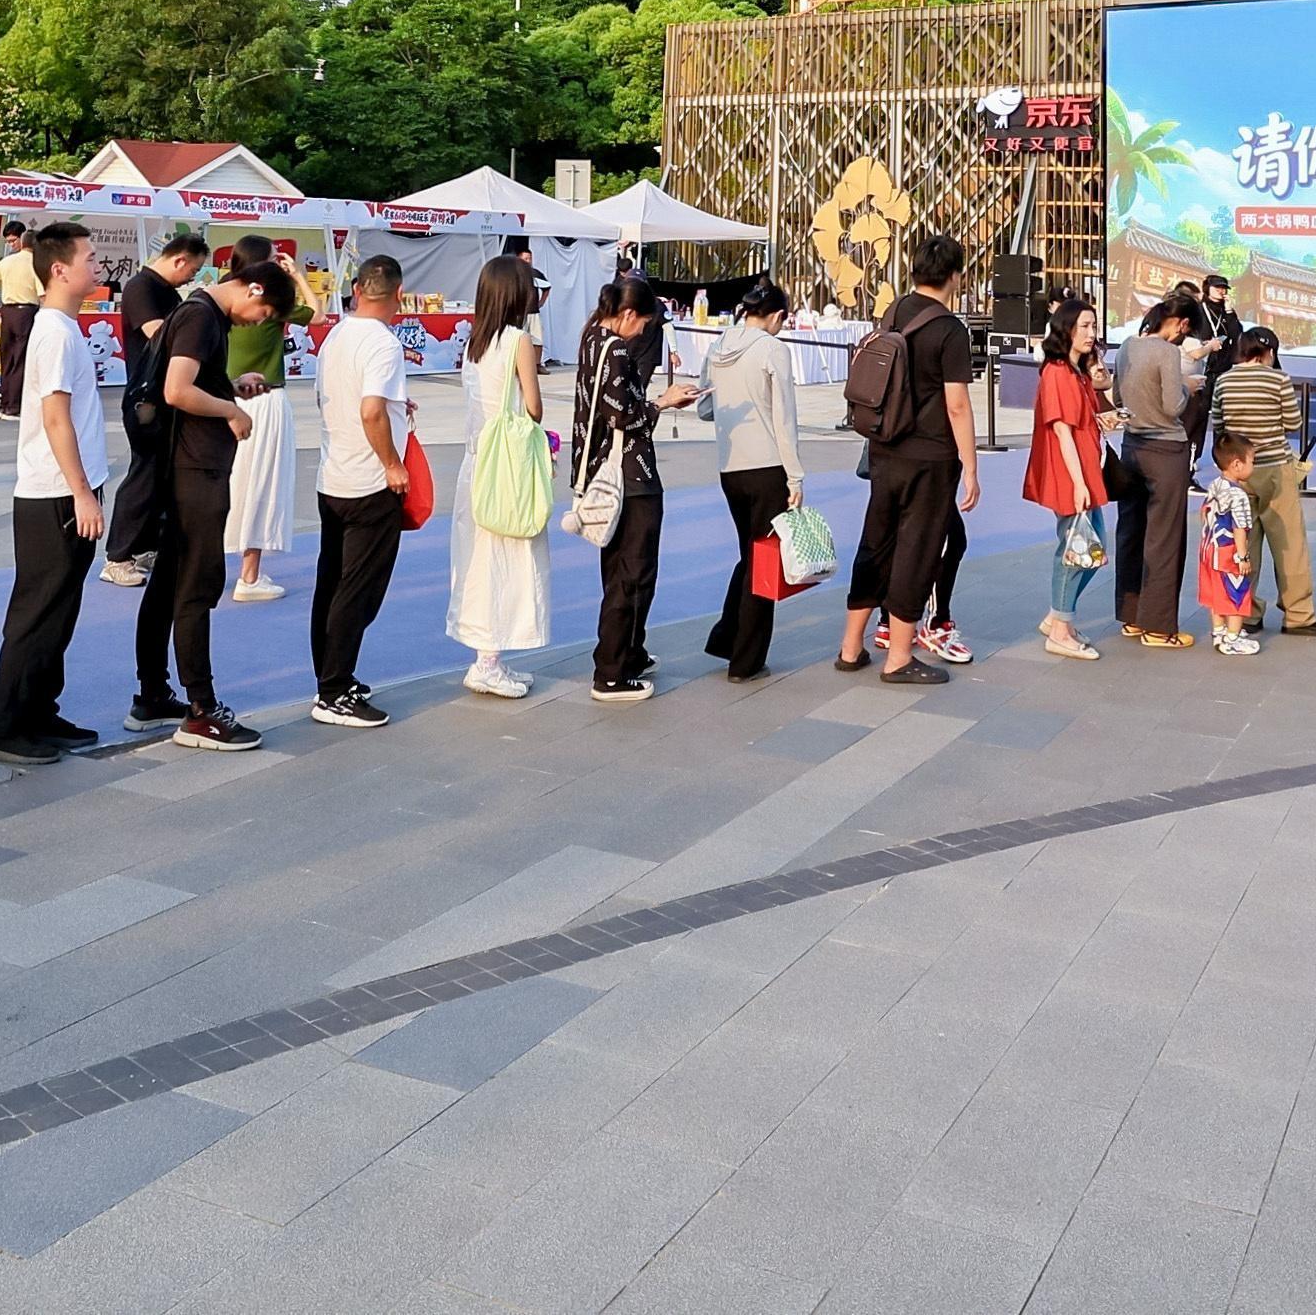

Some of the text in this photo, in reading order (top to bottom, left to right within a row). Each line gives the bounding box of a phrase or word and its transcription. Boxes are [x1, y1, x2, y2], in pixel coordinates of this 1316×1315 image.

[1024, 95, 1093, 128] 京东
[984, 136, 1093, 152] 又好又便宜
